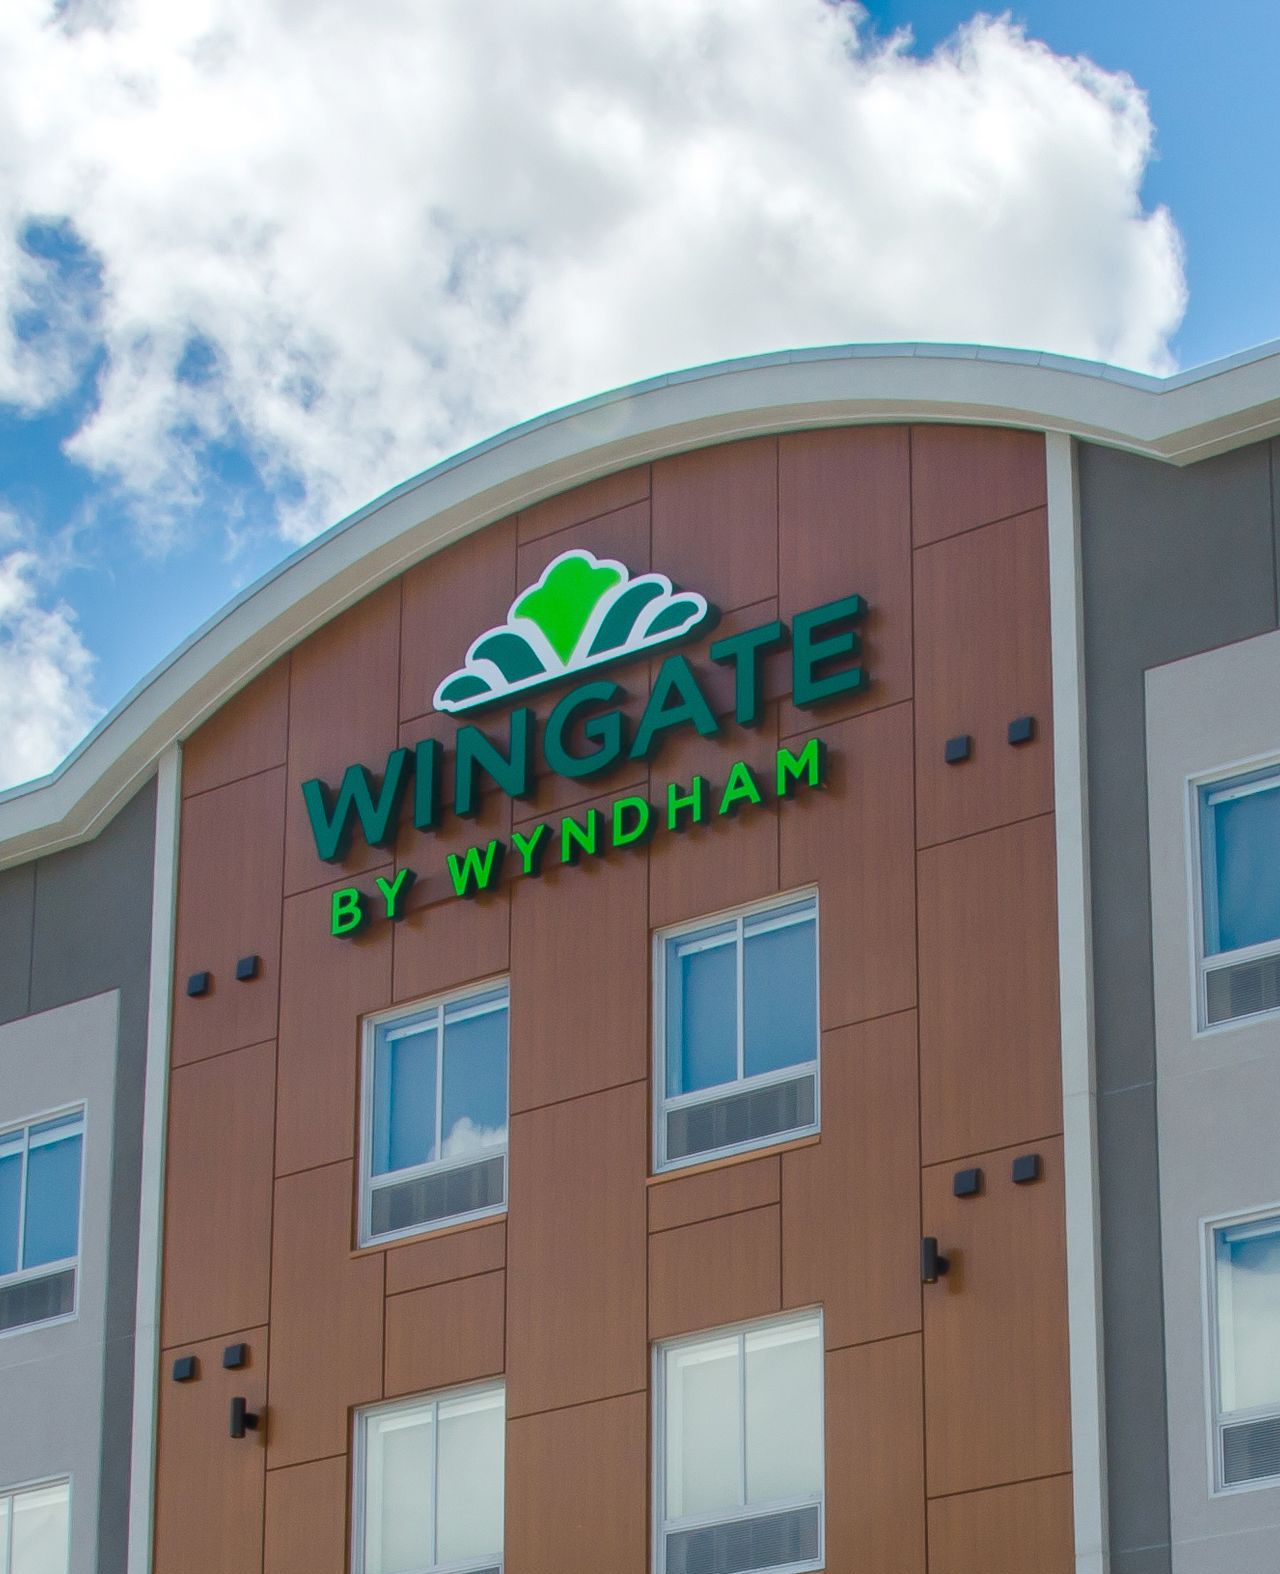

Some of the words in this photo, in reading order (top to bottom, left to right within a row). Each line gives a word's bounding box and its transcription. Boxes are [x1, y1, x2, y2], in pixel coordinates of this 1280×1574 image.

[301, 594, 865, 862] WINGATE
[330, 868, 411, 937] BY
[446, 737, 824, 897] WYNDHAM
